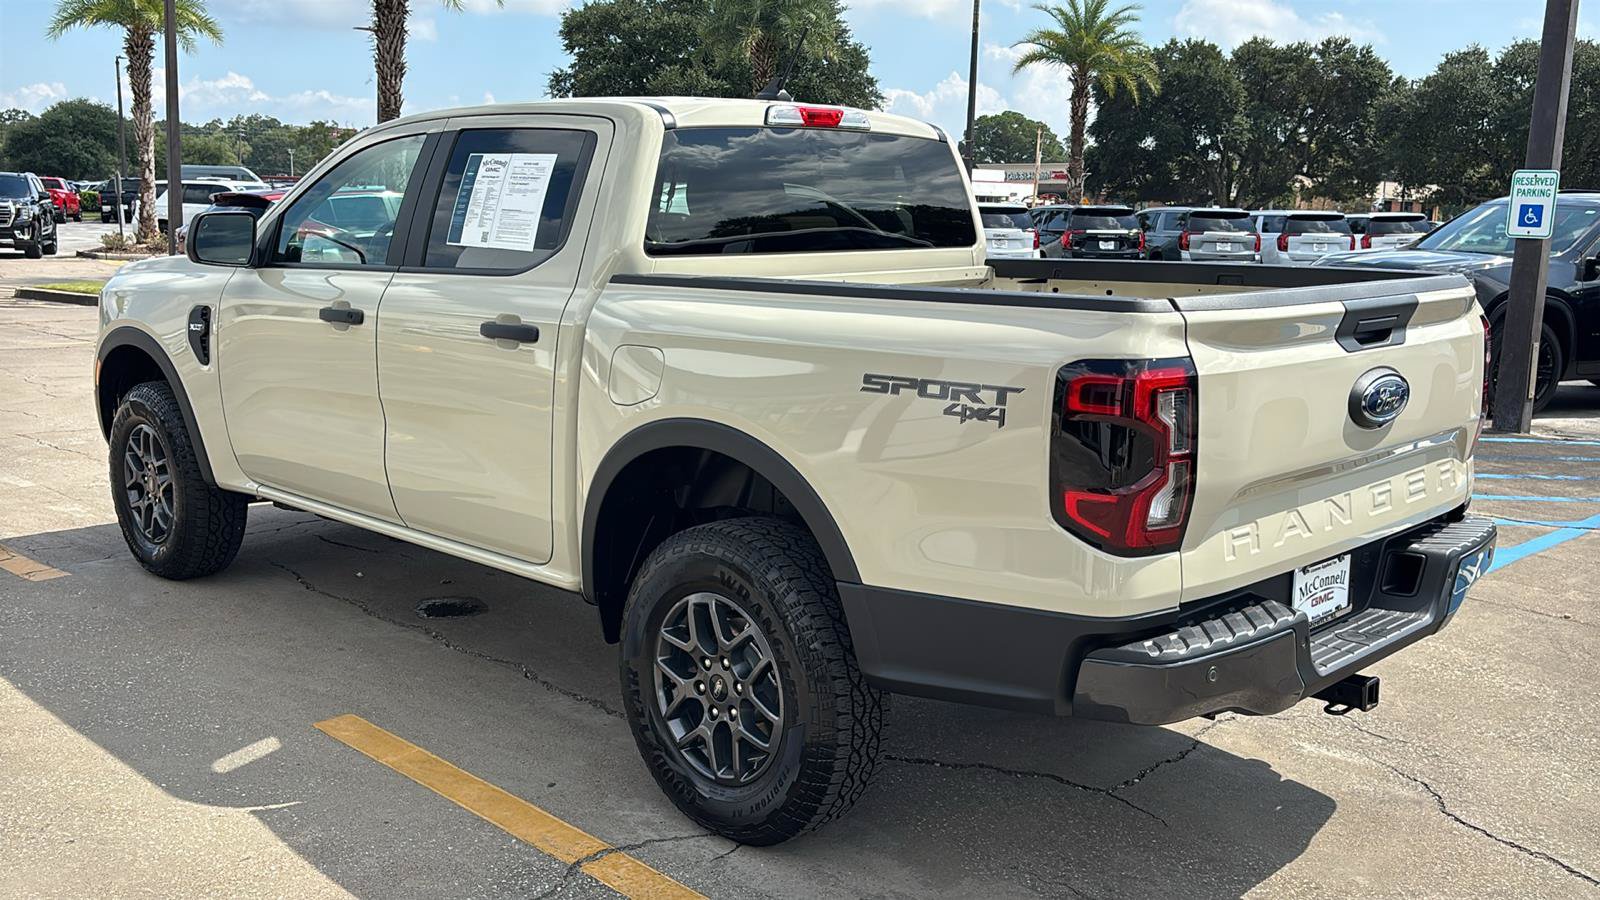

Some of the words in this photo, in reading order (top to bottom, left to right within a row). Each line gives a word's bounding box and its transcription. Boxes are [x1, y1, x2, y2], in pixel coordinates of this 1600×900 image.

[1515, 177, 1555, 186] RESERVED
[1516, 188, 1551, 198] PARKING
[860, 373, 1026, 406] SPORT
[1223, 458, 1458, 562] RANGER
[1299, 570, 1347, 601] McConnell
[1311, 591, 1334, 608] GMC
